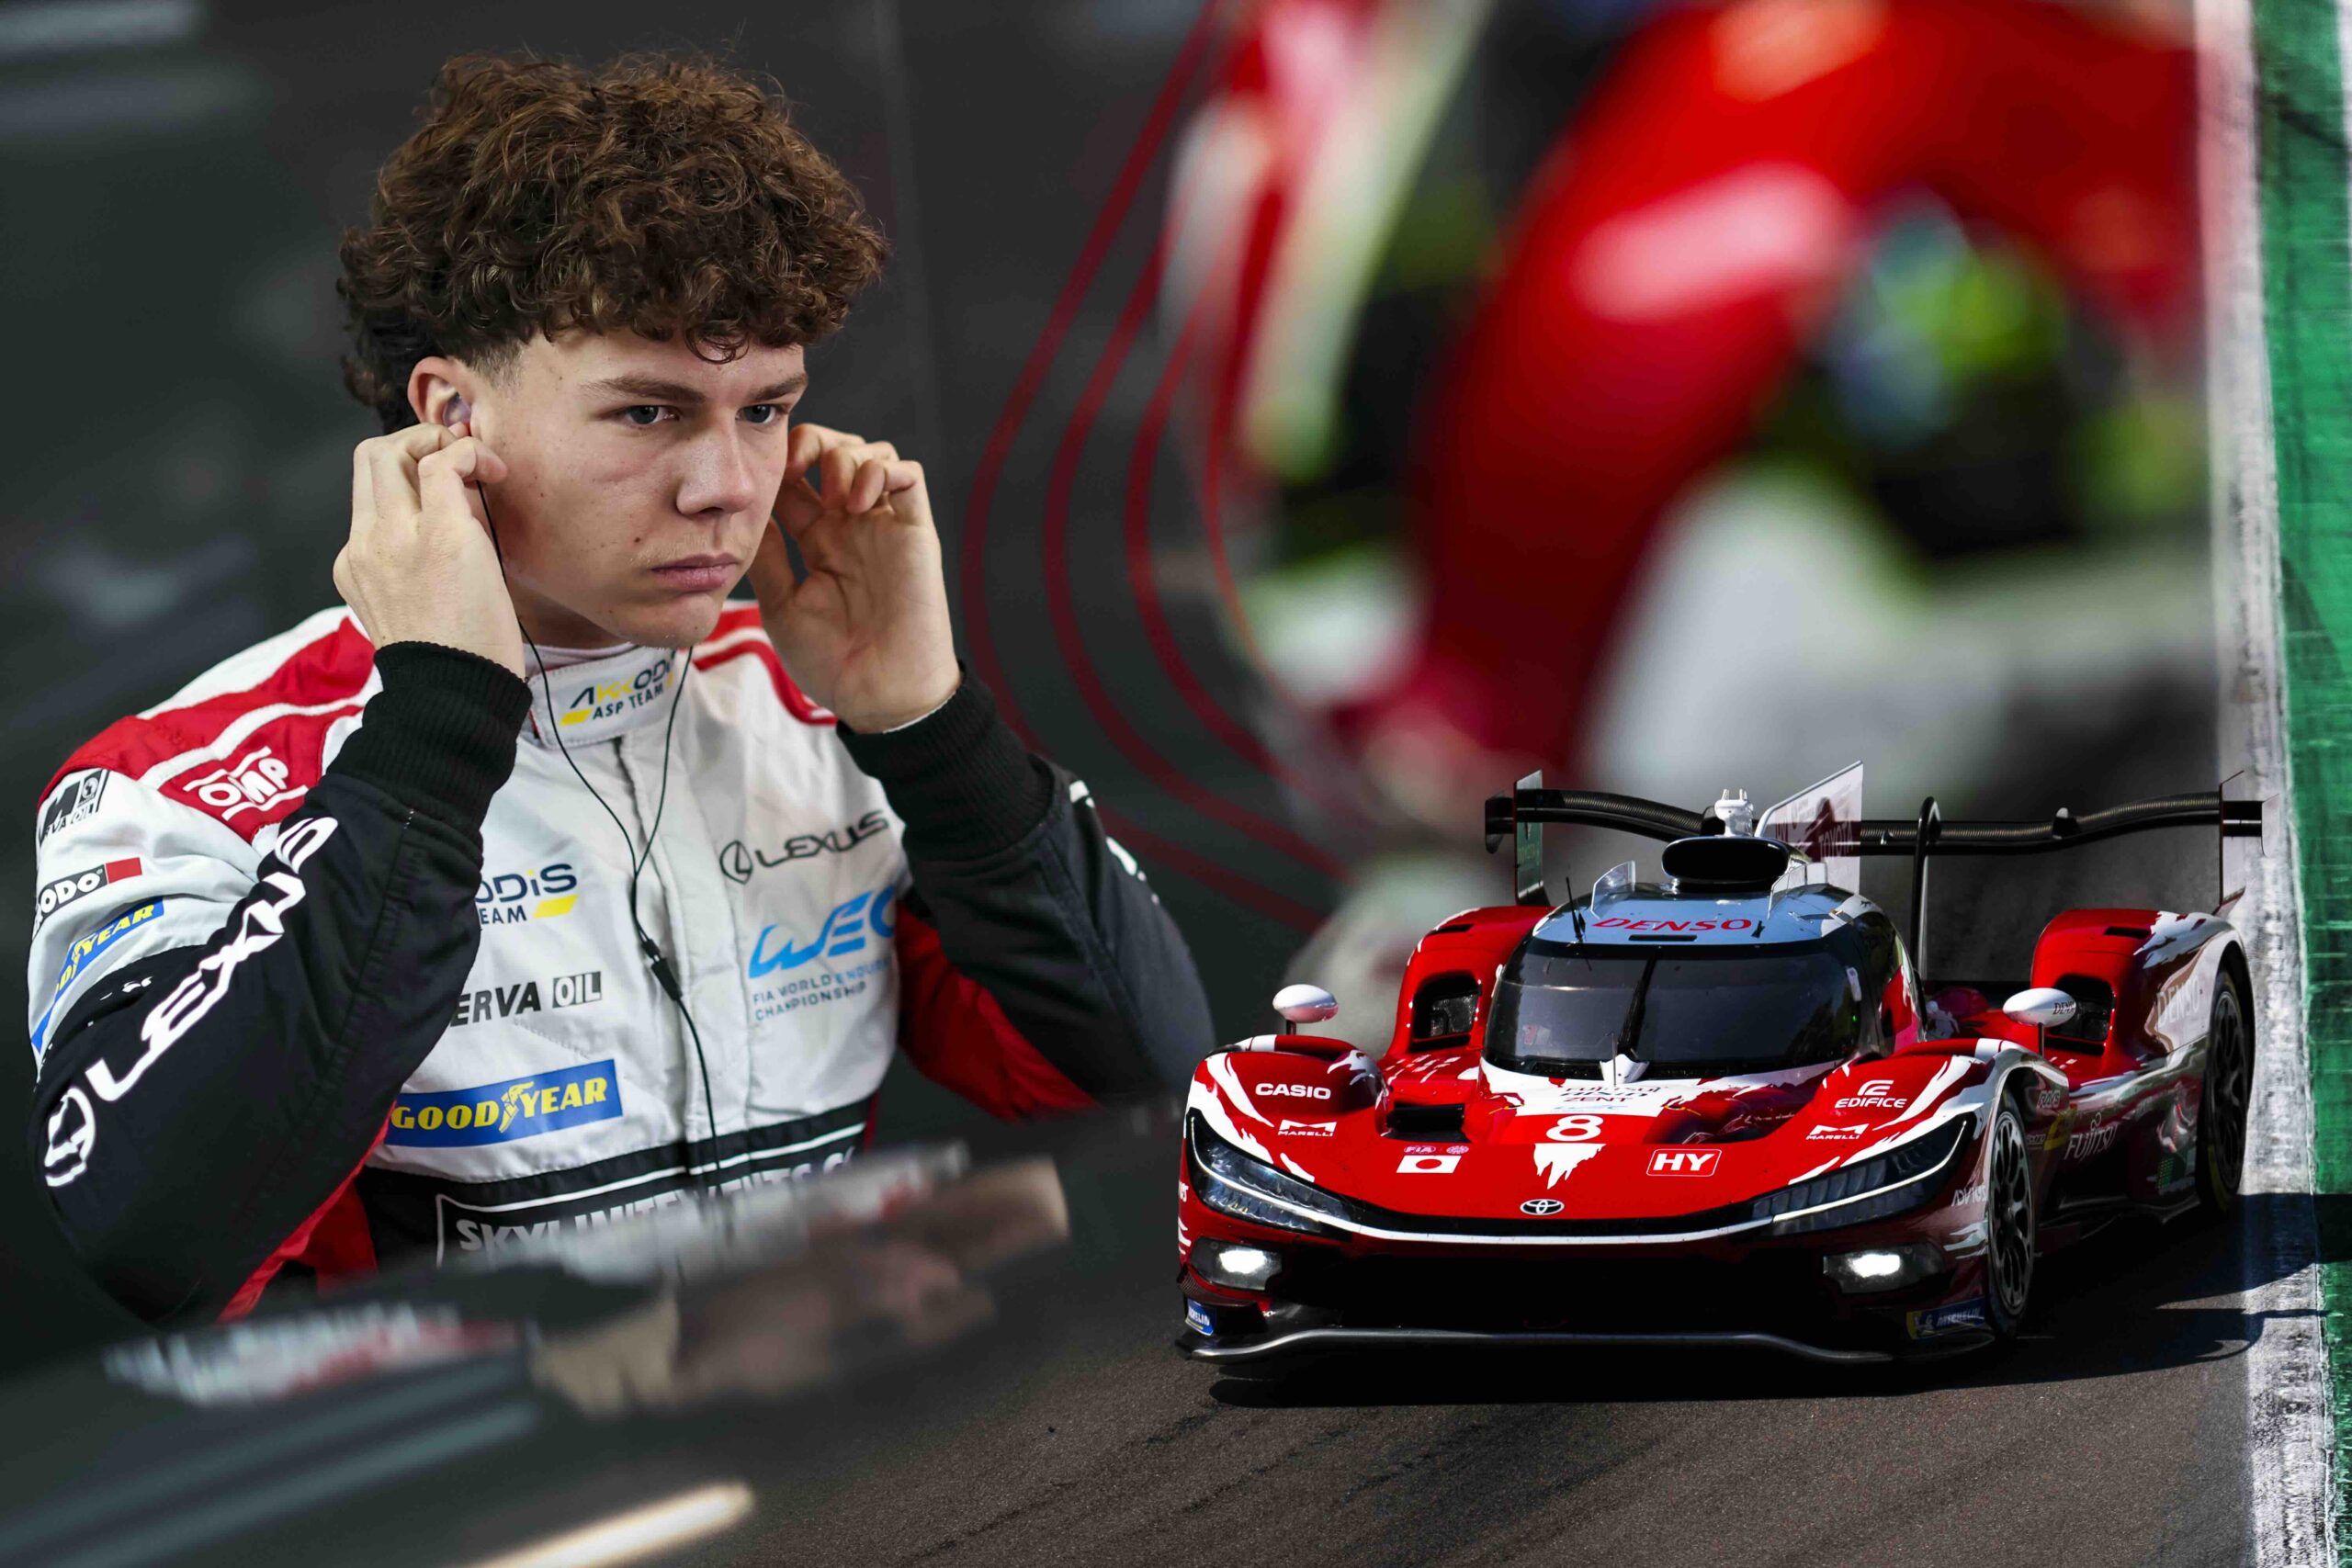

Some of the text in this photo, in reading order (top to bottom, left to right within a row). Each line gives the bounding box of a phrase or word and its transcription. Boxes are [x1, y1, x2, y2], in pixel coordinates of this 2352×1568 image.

[593, 682, 664, 720] ASP TEAM
[755, 810, 889, 868] LEXUS
[480, 905, 527, 925] EAM
[1592, 917, 1752, 931] DENSO
[450, 973, 602, 1028] ERVA OIL
[752, 992, 775, 1005] FIA
[778, 974, 832, 997] WORLD
[755, 980, 866, 1021] CHAMPIONSHIP
[390, 1077, 608, 1133] GOODYEAR
[1255, 1083, 1331, 1100] CASIO
[1834, 1097, 1908, 1109] EDIFICE
[1545, 1114, 1604, 1142] 8
[1653, 1153, 1715, 1171] HY
